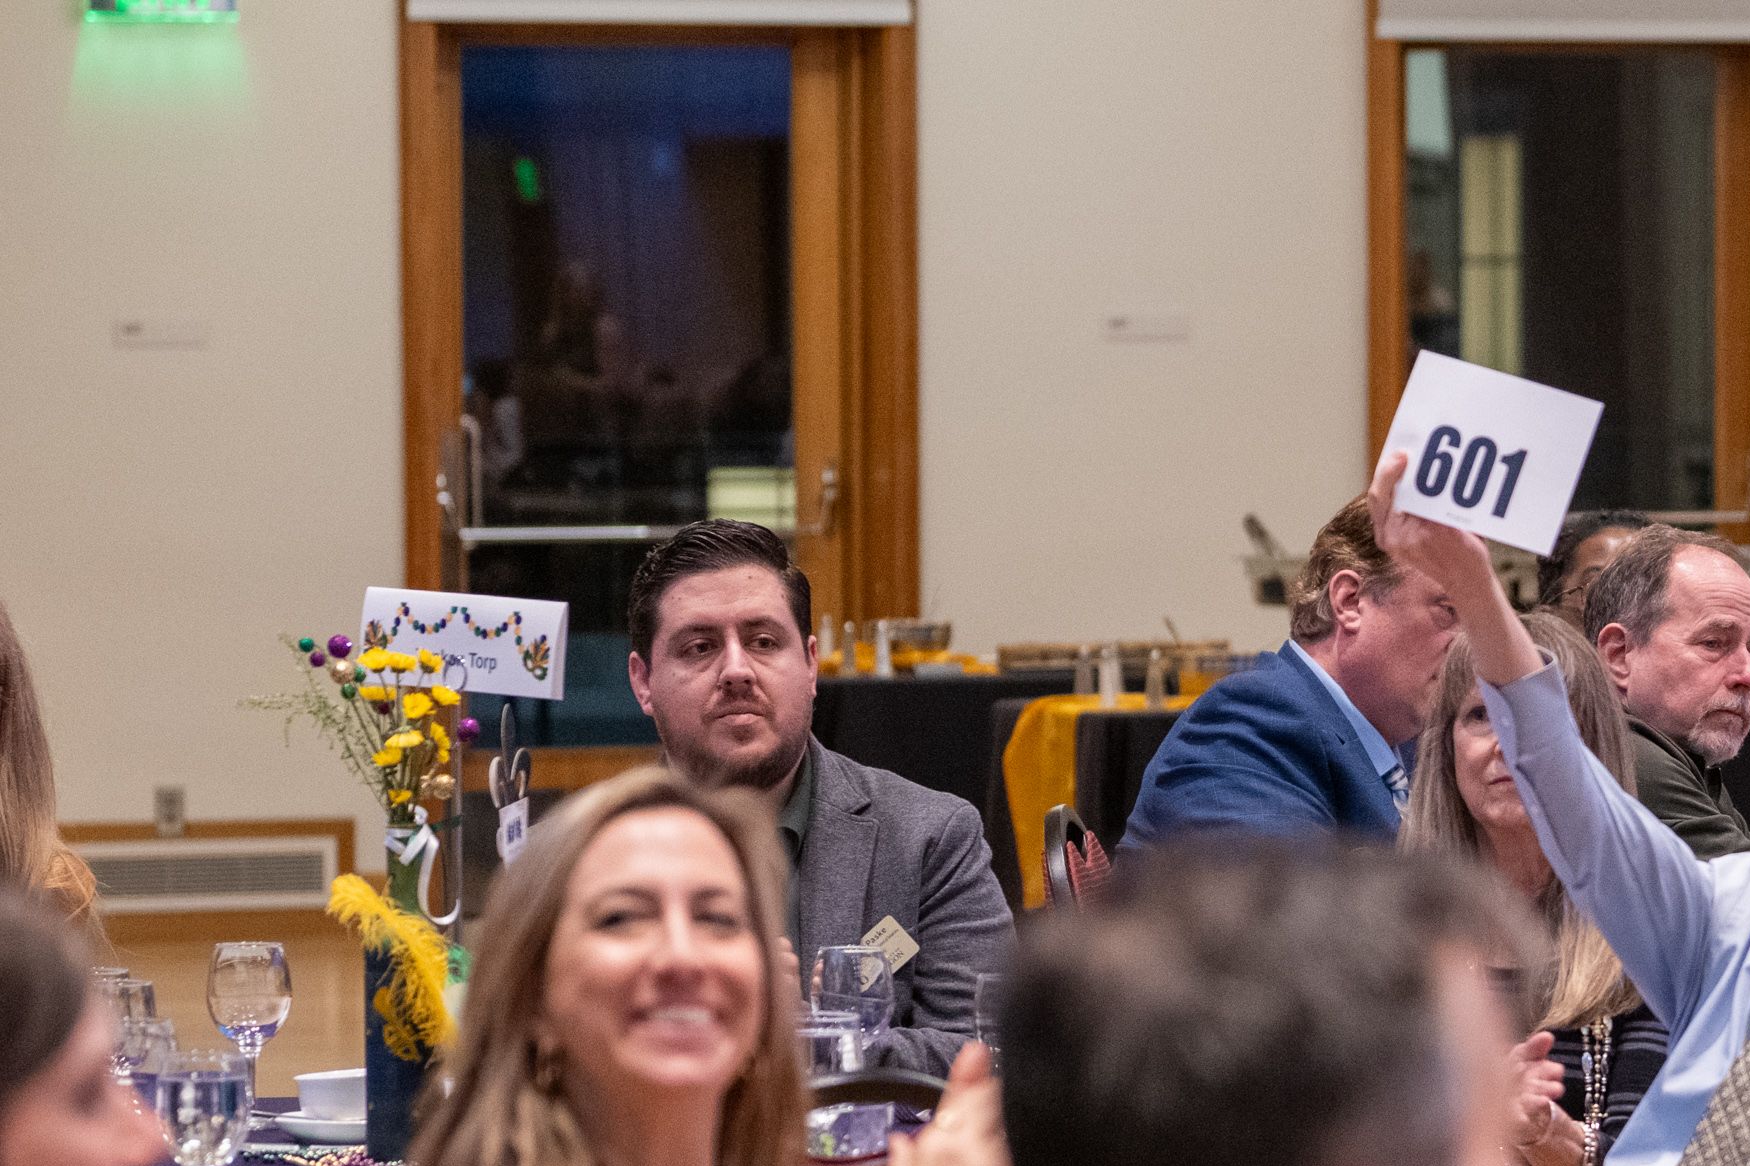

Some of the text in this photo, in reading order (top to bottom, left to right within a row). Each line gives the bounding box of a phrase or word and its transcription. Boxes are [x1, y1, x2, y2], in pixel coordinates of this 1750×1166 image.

[1415, 424, 1528, 519] 601
[468, 652, 497, 674] Torp
[865, 927, 887, 946] Paske
